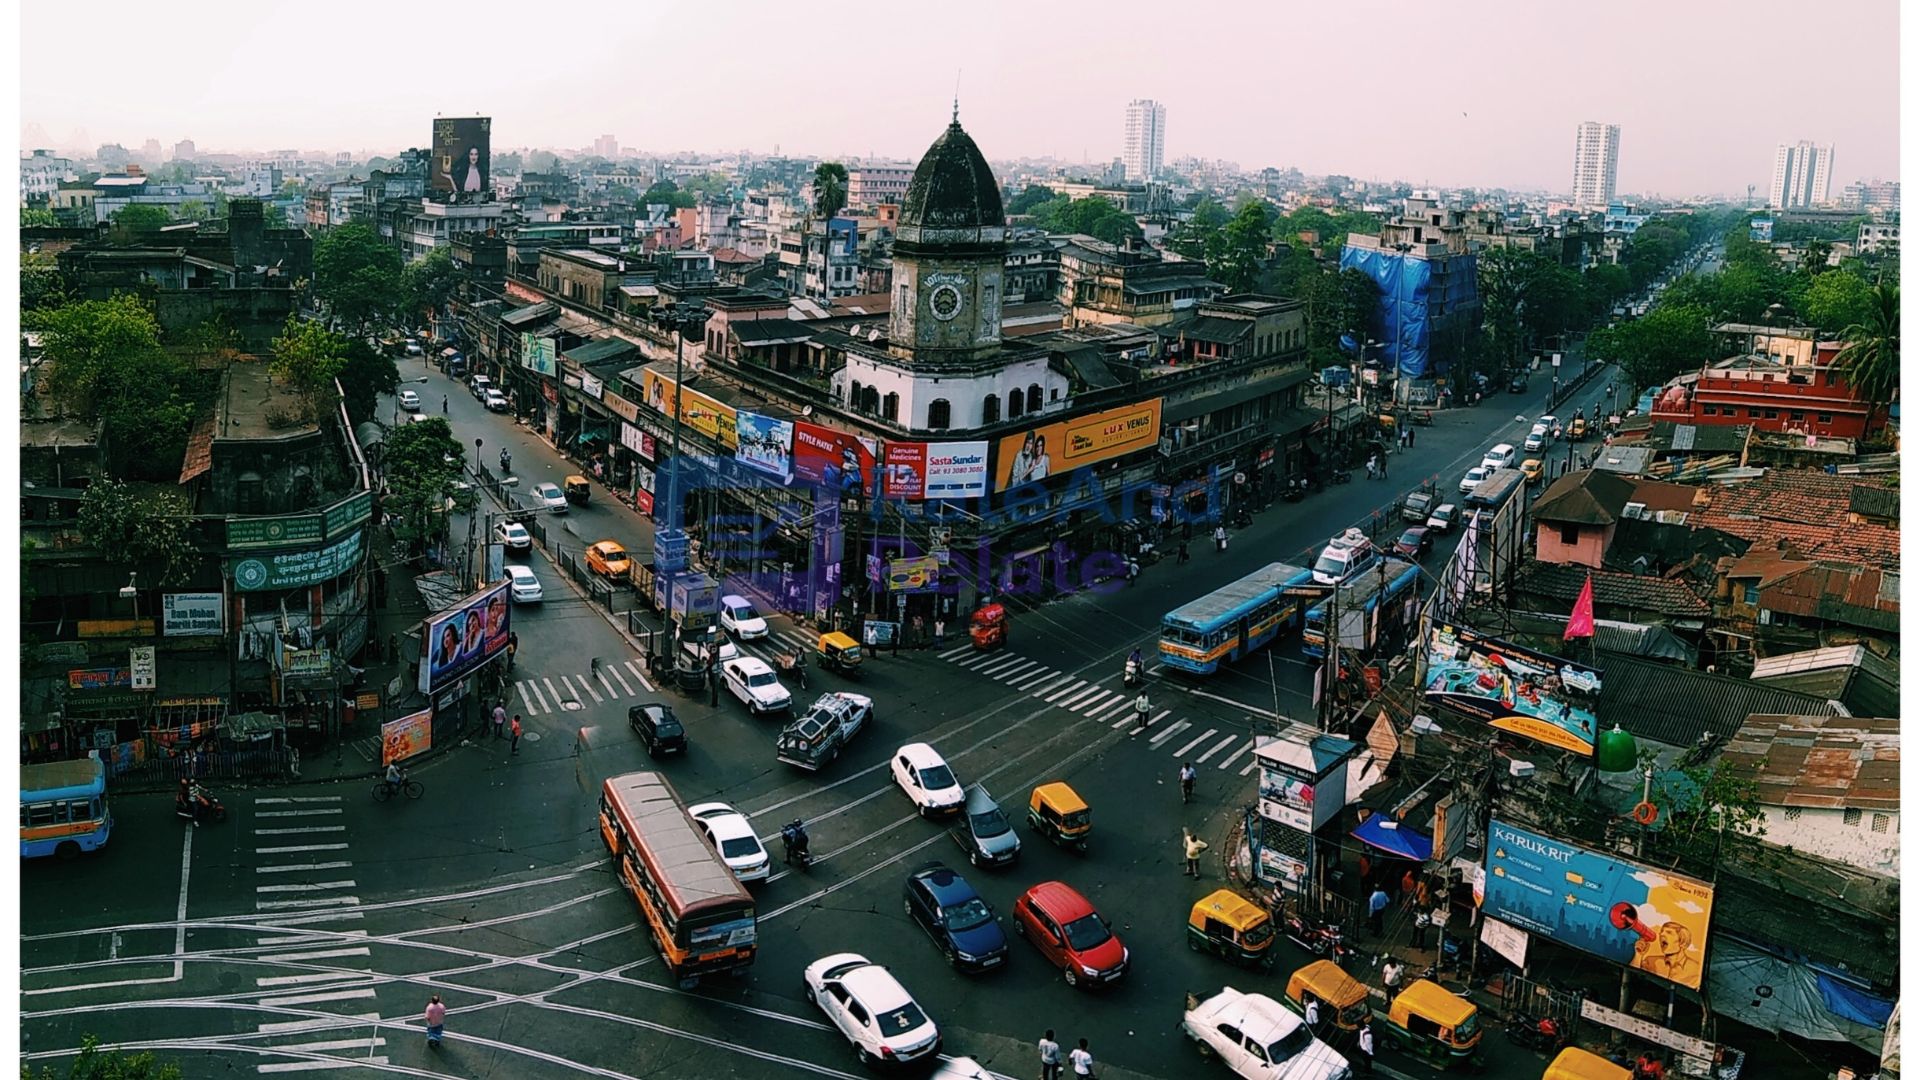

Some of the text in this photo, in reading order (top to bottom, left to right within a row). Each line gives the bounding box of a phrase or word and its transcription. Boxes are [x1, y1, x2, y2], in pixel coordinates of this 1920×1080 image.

[1103, 416, 1149, 435] LUX VENUS
[798, 432, 816, 446] STYLE
[929, 455, 982, 466] SastaSundar
[272, 569, 333, 585] United Bank
[1259, 757, 1277, 768] FOLLOW
[1279, 764, 1297, 774] TRAFFIC
[1494, 827, 1572, 863] KARUKRIT
[1508, 856, 1542, 872] ACTIVATION
[1507, 874, 1553, 896] MERCHANDISING
[1579, 900, 1604, 912] EVENTS
